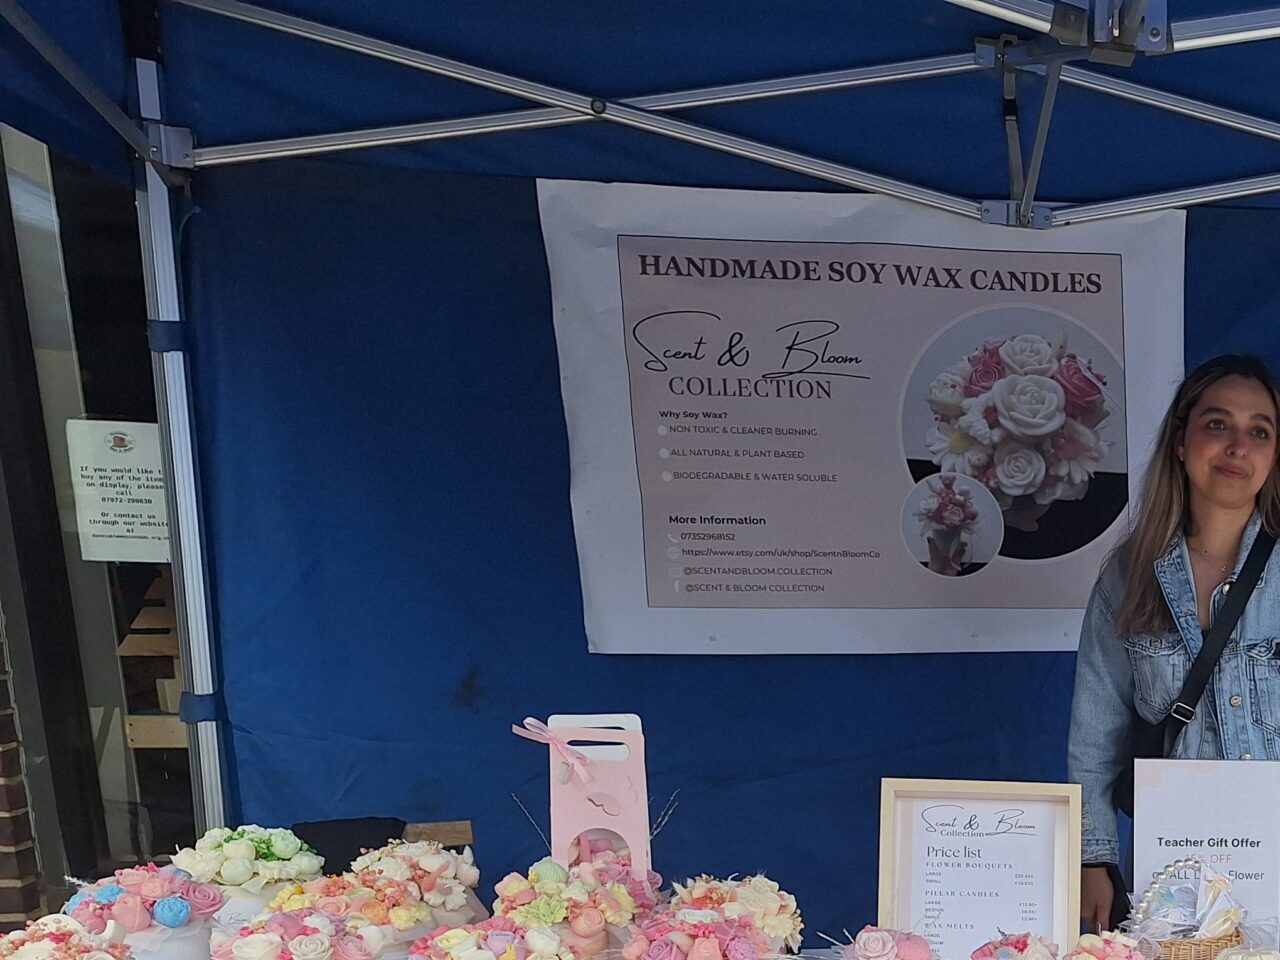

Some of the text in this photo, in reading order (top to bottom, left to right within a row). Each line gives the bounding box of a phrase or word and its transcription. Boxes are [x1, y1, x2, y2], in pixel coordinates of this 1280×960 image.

[638, 254, 1102, 294] HANDMADE SOY WAX CANDLES
[632, 310, 871, 379] Scent & Bloom
[668, 376, 832, 399] COLLECTION
[659, 410, 728, 419] Why Soy Wax?
[669, 425, 818, 436] NON TOXIC & CLEANER BURNING
[670, 449, 688, 457] ALL
[689, 449, 732, 457] NATURAL
[742, 450, 772, 458] PLANT
[774, 450, 805, 459] BASED
[110, 466, 132, 474] would
[673, 471, 838, 482] BIODEGRADABLE & WATER SOLUBLE
[669, 515, 767, 525] More Information
[685, 584, 724, 592] @SCENT
[733, 584, 767, 592] BLOOM
[769, 584, 825, 593] COLLECTION
[921, 804, 1038, 836] Scent & Bloom
[940, 830, 985, 838] Collection
[1157, 837, 1261, 848] Teacher Gift Offer
[926, 845, 982, 858] Price list
[1210, 854, 1233, 864] OFF
[1228, 870, 1264, 880] Flower
